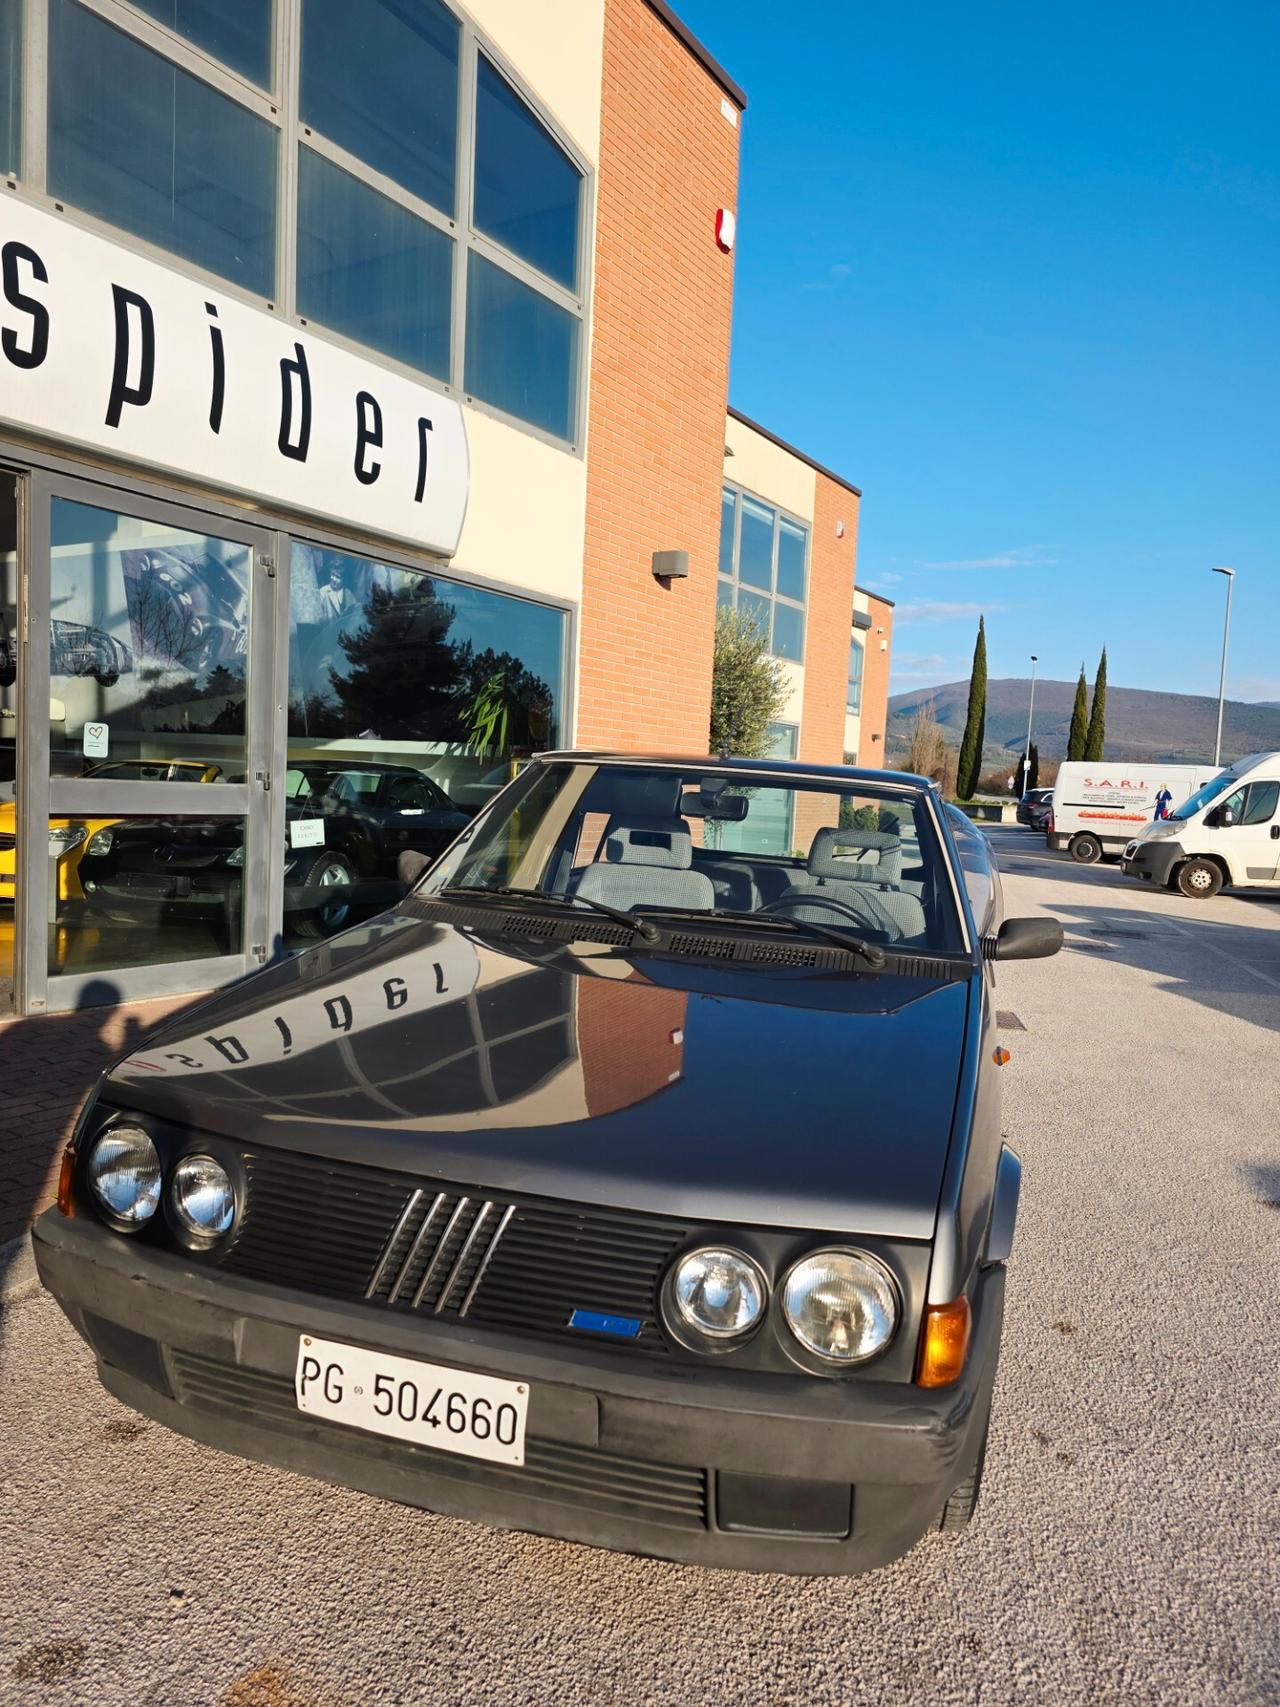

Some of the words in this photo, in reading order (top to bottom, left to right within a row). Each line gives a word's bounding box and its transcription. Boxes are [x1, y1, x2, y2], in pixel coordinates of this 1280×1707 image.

[1, 241, 433, 503] spider
[302, 1356, 345, 1404] PG
[373, 1373, 518, 1446] 504660
